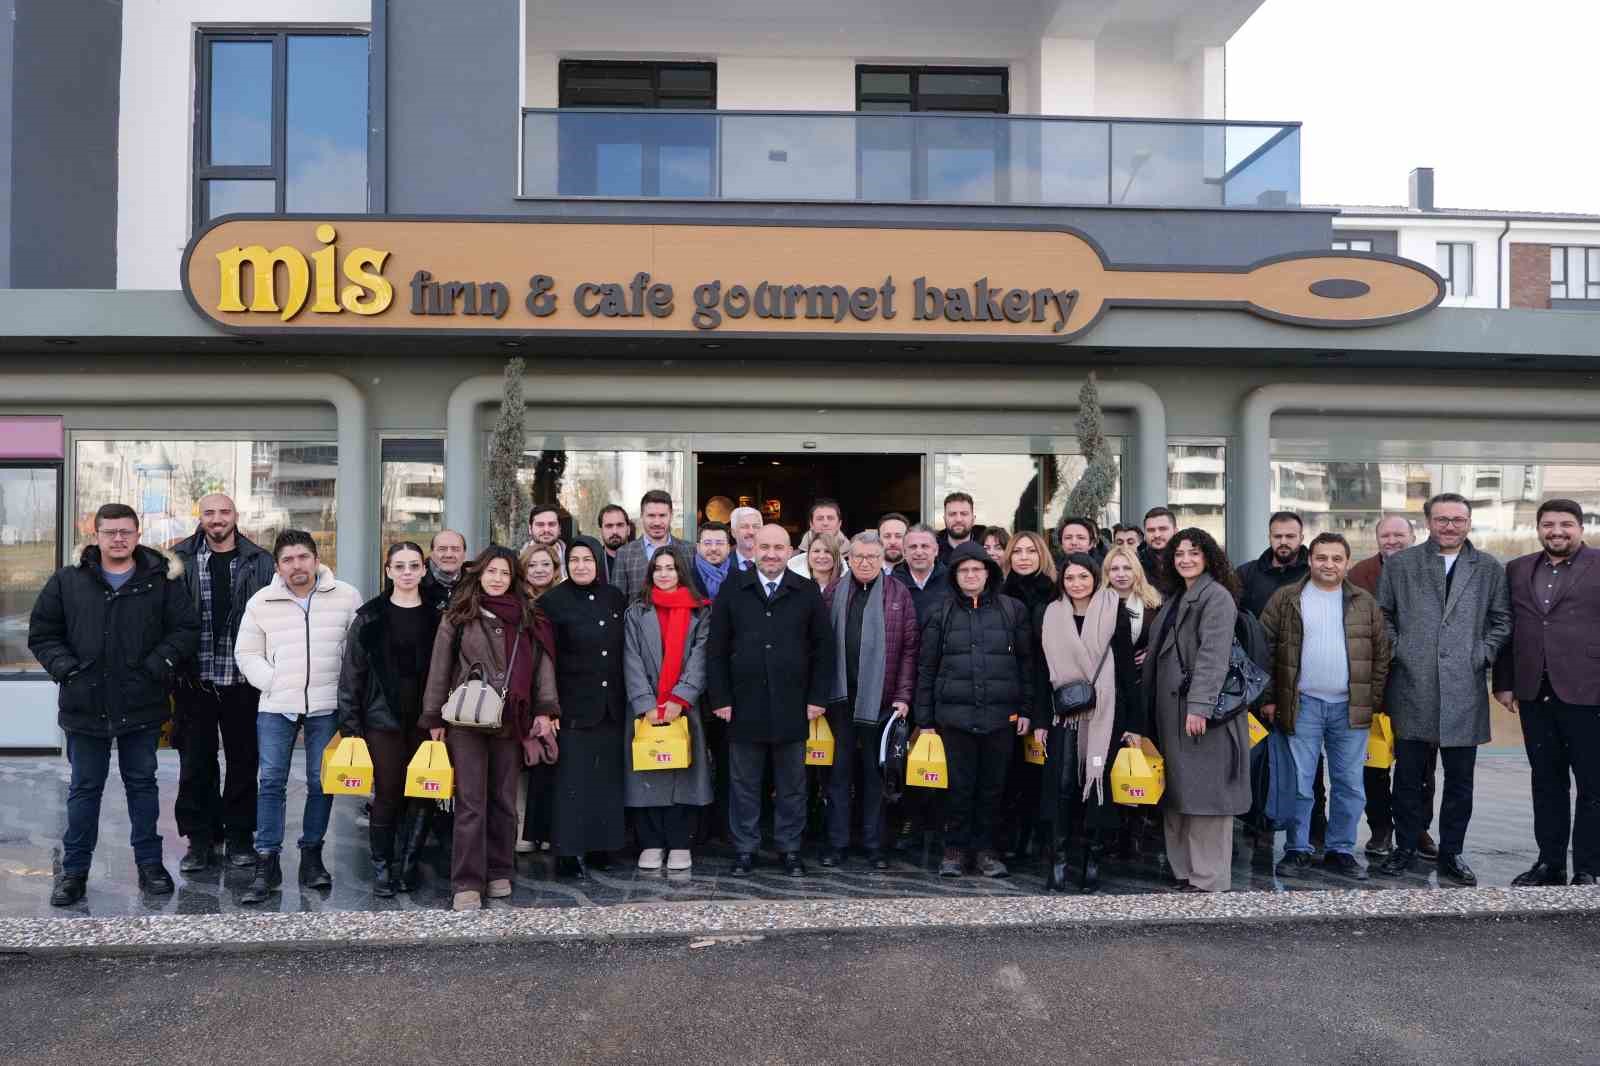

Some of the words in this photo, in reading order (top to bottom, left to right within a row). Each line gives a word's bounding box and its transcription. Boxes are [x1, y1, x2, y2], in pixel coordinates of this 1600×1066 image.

[217, 224, 394, 322] mis
[525, 274, 557, 318] &
[574, 271, 675, 318] cafe
[692, 275, 896, 330] gourmet
[913, 276, 1080, 333] bakery
